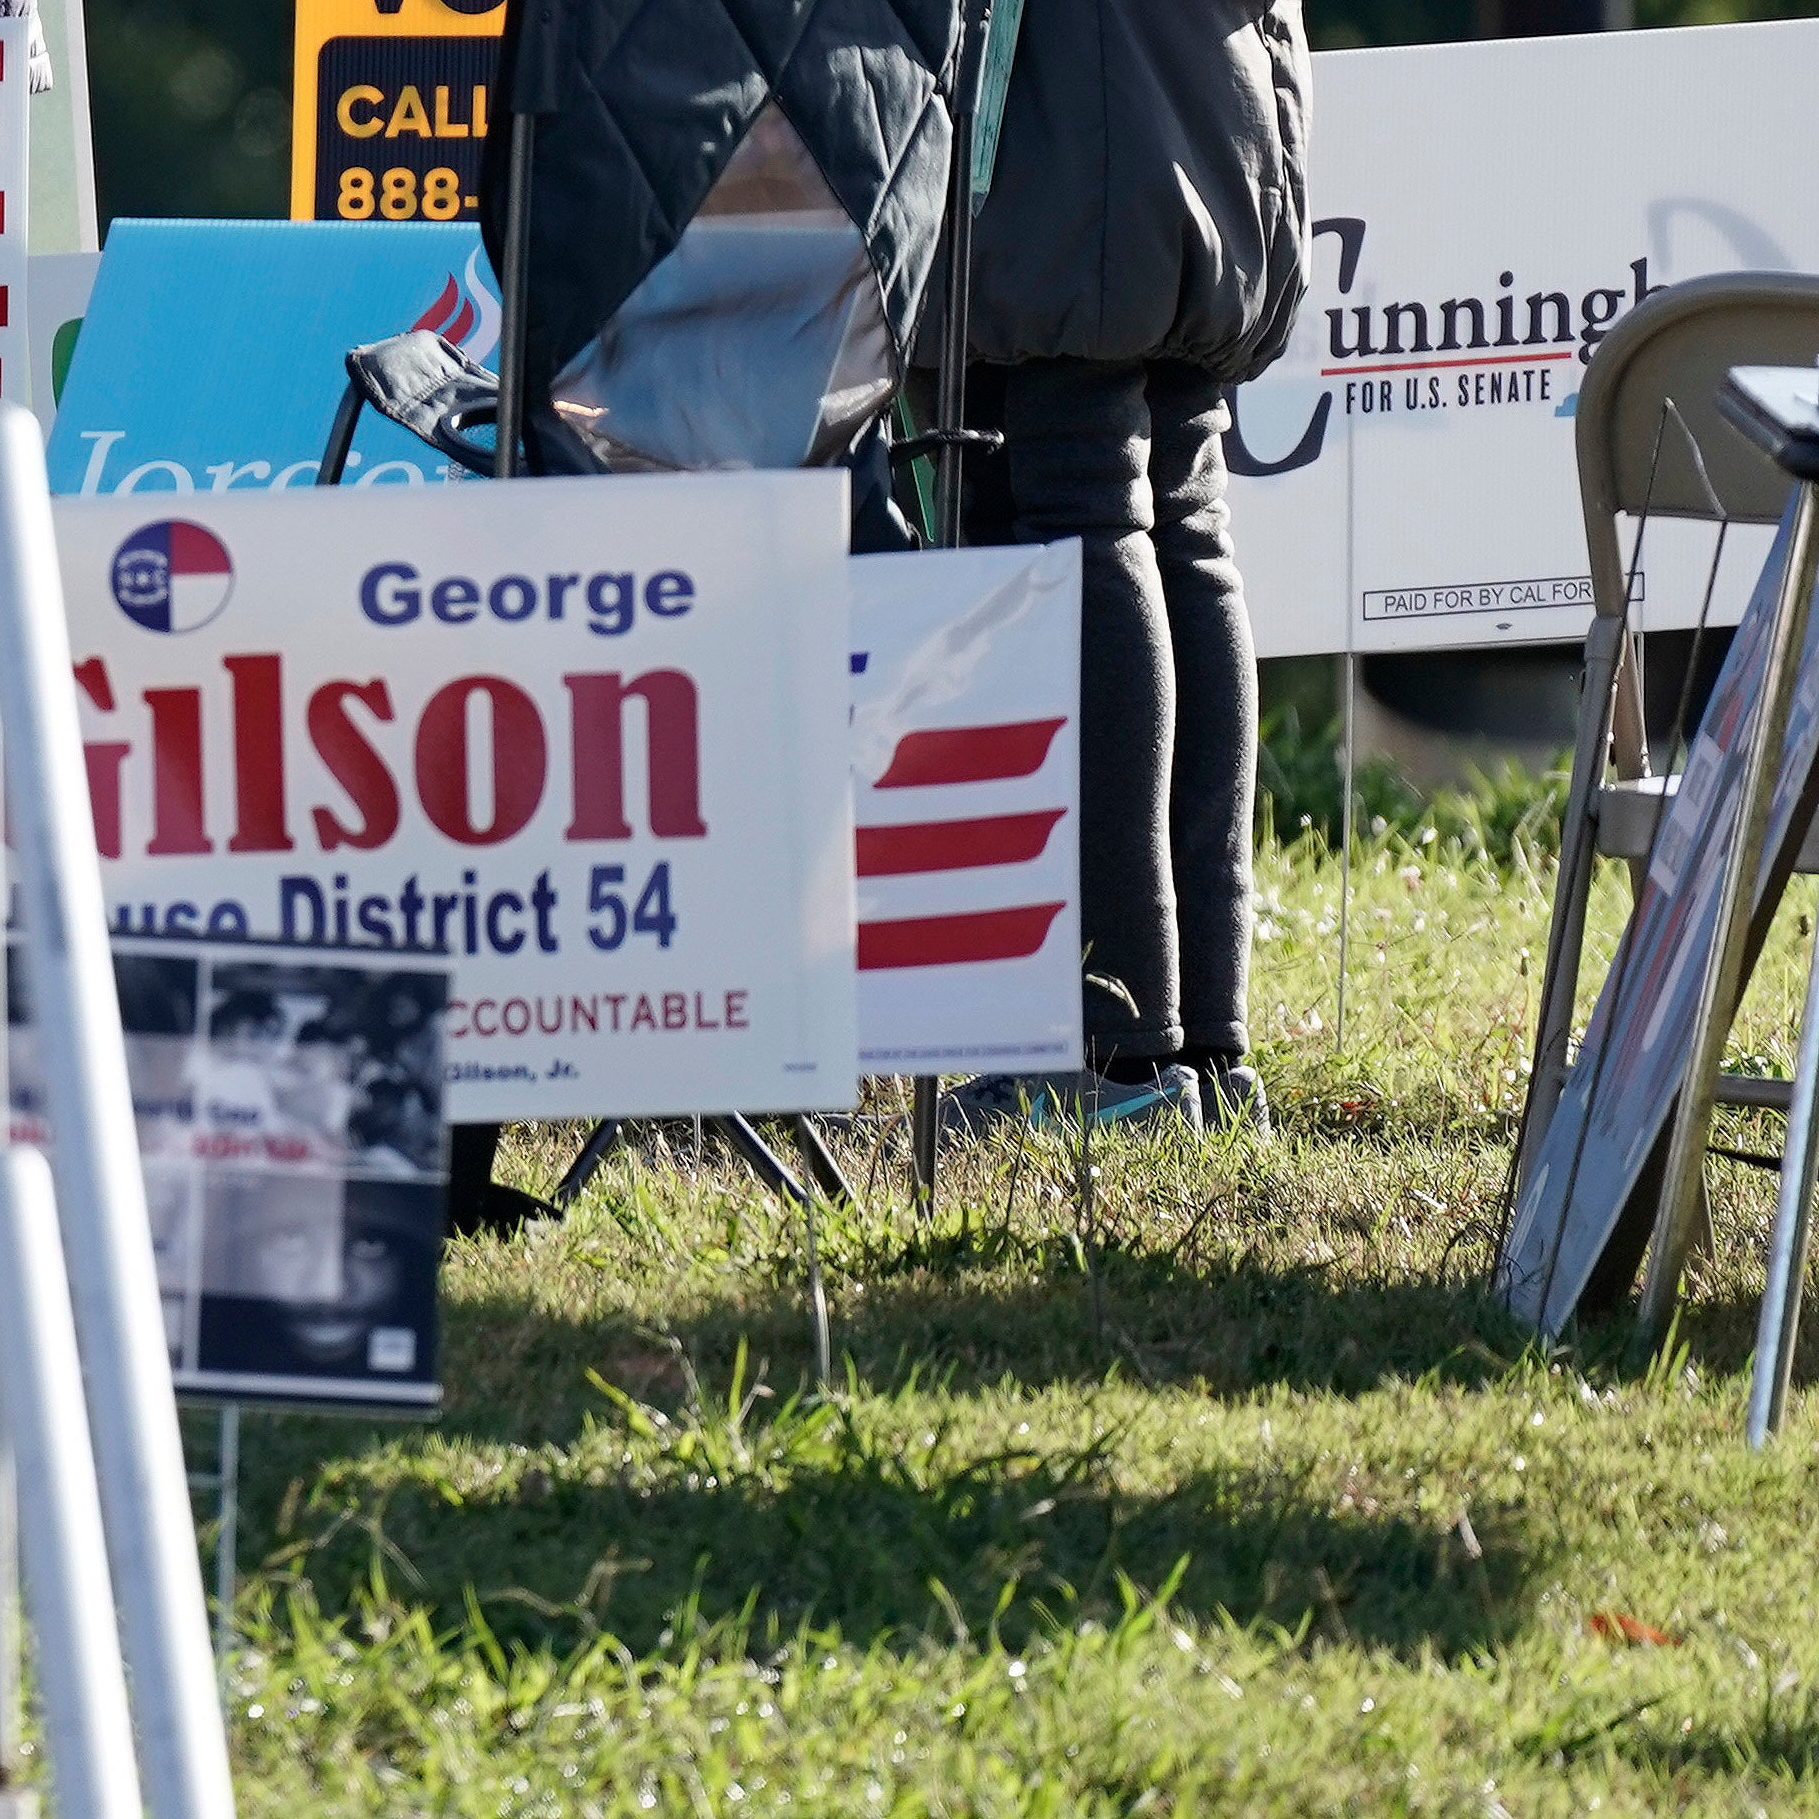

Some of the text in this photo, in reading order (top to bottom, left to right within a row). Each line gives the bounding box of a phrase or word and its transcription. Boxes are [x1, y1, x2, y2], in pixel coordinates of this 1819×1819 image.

[337, 166, 479, 220] 888-
[1345, 368, 1552, 416] FOR U.S. SENATE
[360, 561, 696, 636] George
[1384, 581, 1593, 613] PAID FOR BY CAL FOR
[278, 868, 559, 955] District
[586, 861, 678, 952] 54
[446, 989, 750, 1038] CCOUNTABLE
